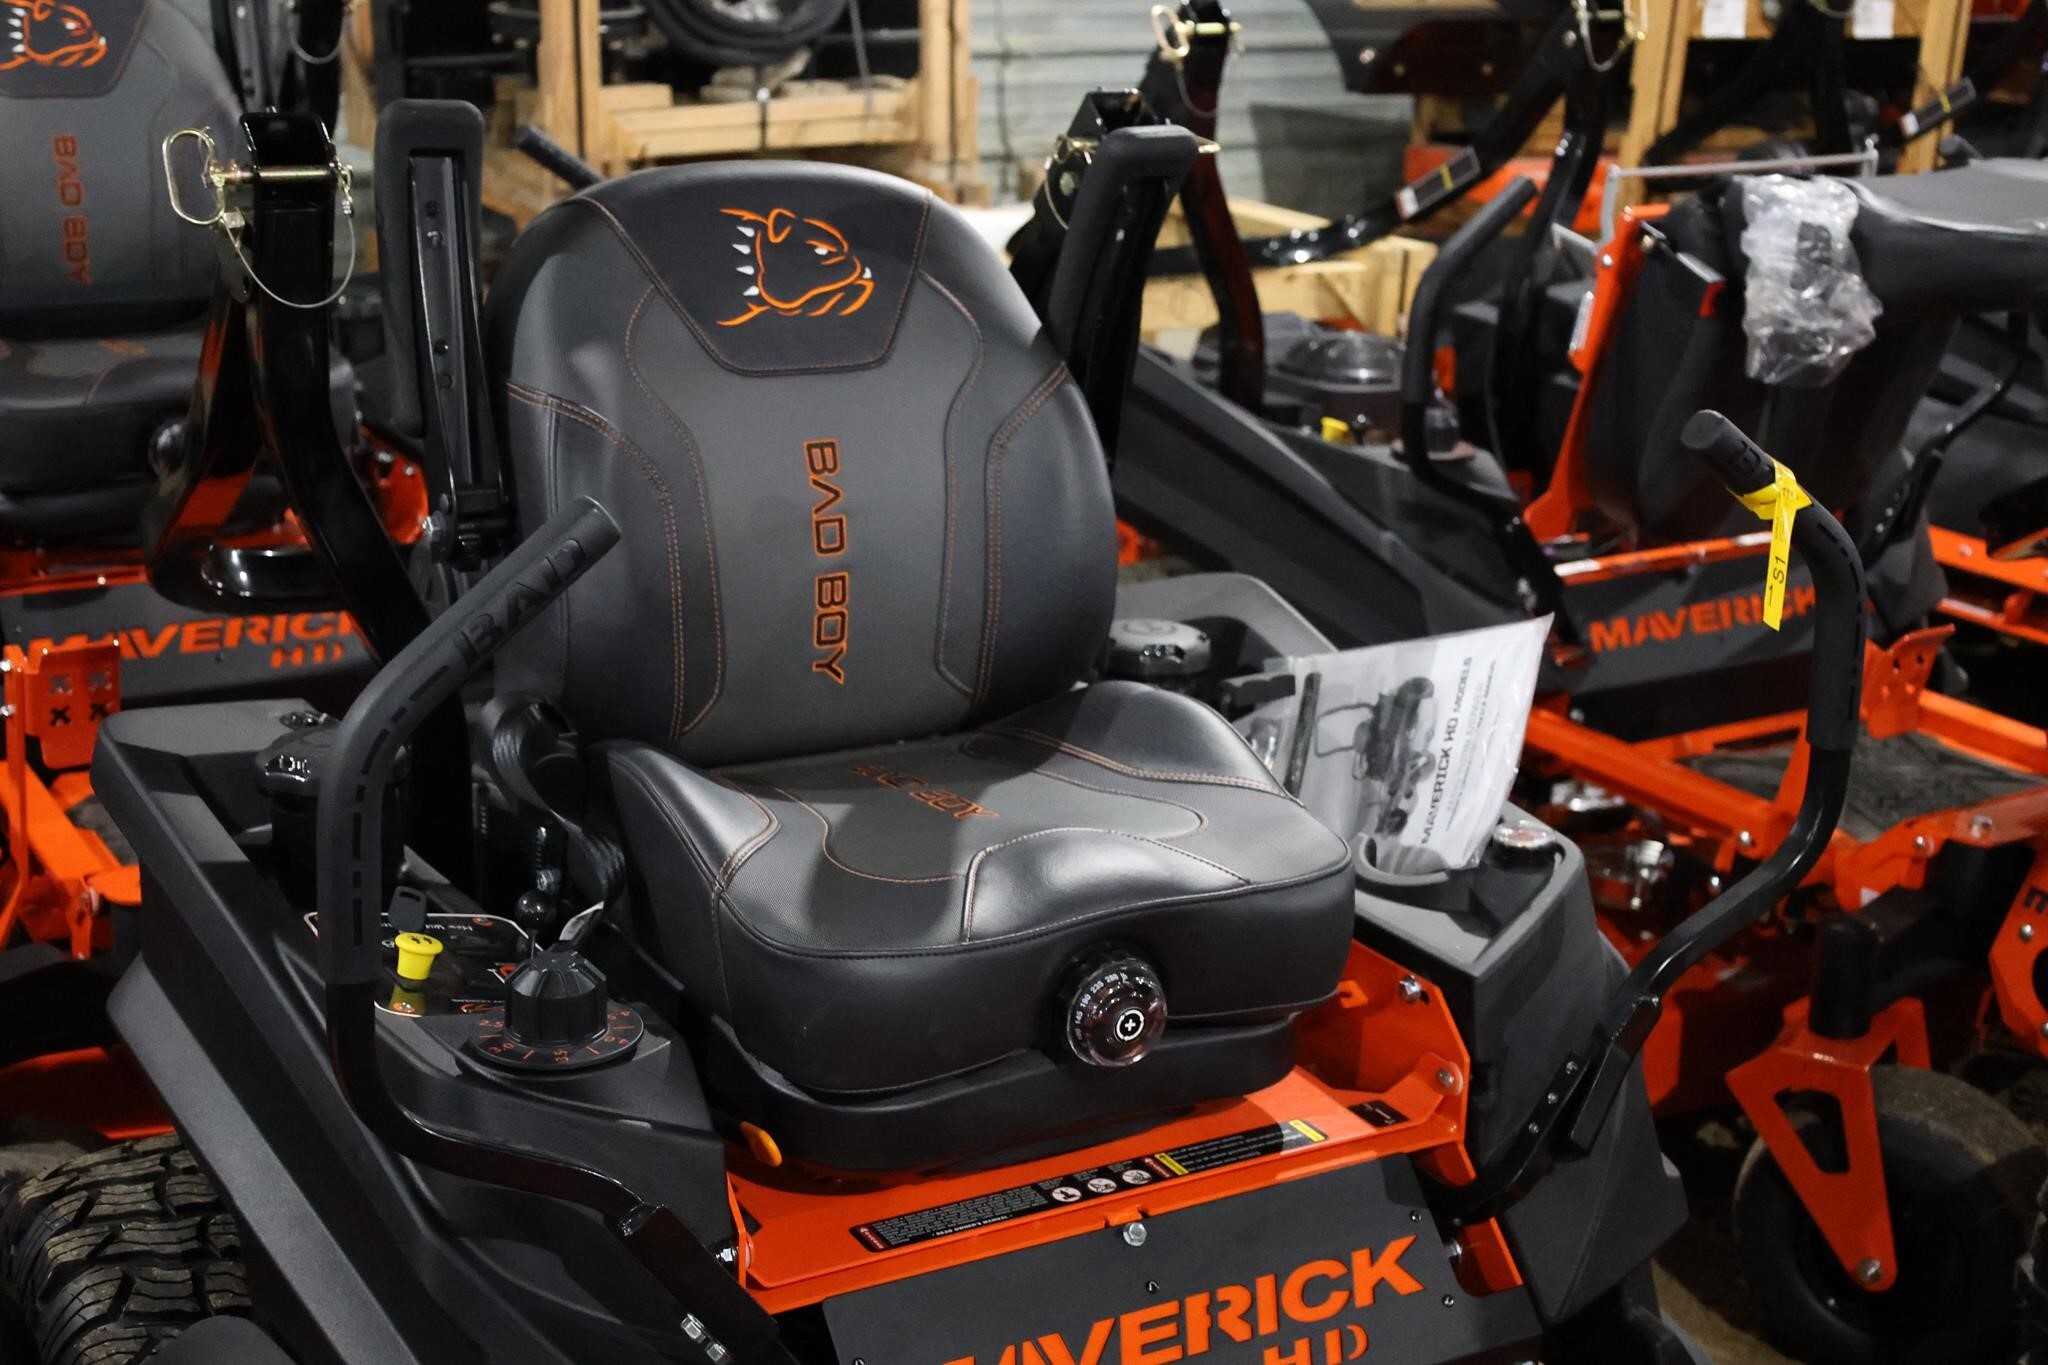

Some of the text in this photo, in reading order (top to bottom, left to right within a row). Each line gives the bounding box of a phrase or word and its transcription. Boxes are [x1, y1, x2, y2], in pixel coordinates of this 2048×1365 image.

[53, 134, 95, 287] BAD BOY
[453, 537, 586, 668] BAD
[803, 438, 849, 685] BAD BOY
[1772, 556, 1786, 584] S1
[270, 641, 345, 669] HD
[909, 788, 999, 819] BOY
[1421, 746, 1452, 845] MAVERICK
[1444, 716, 1459, 742] HD
[943, 1235, 1426, 1365] VERICK
